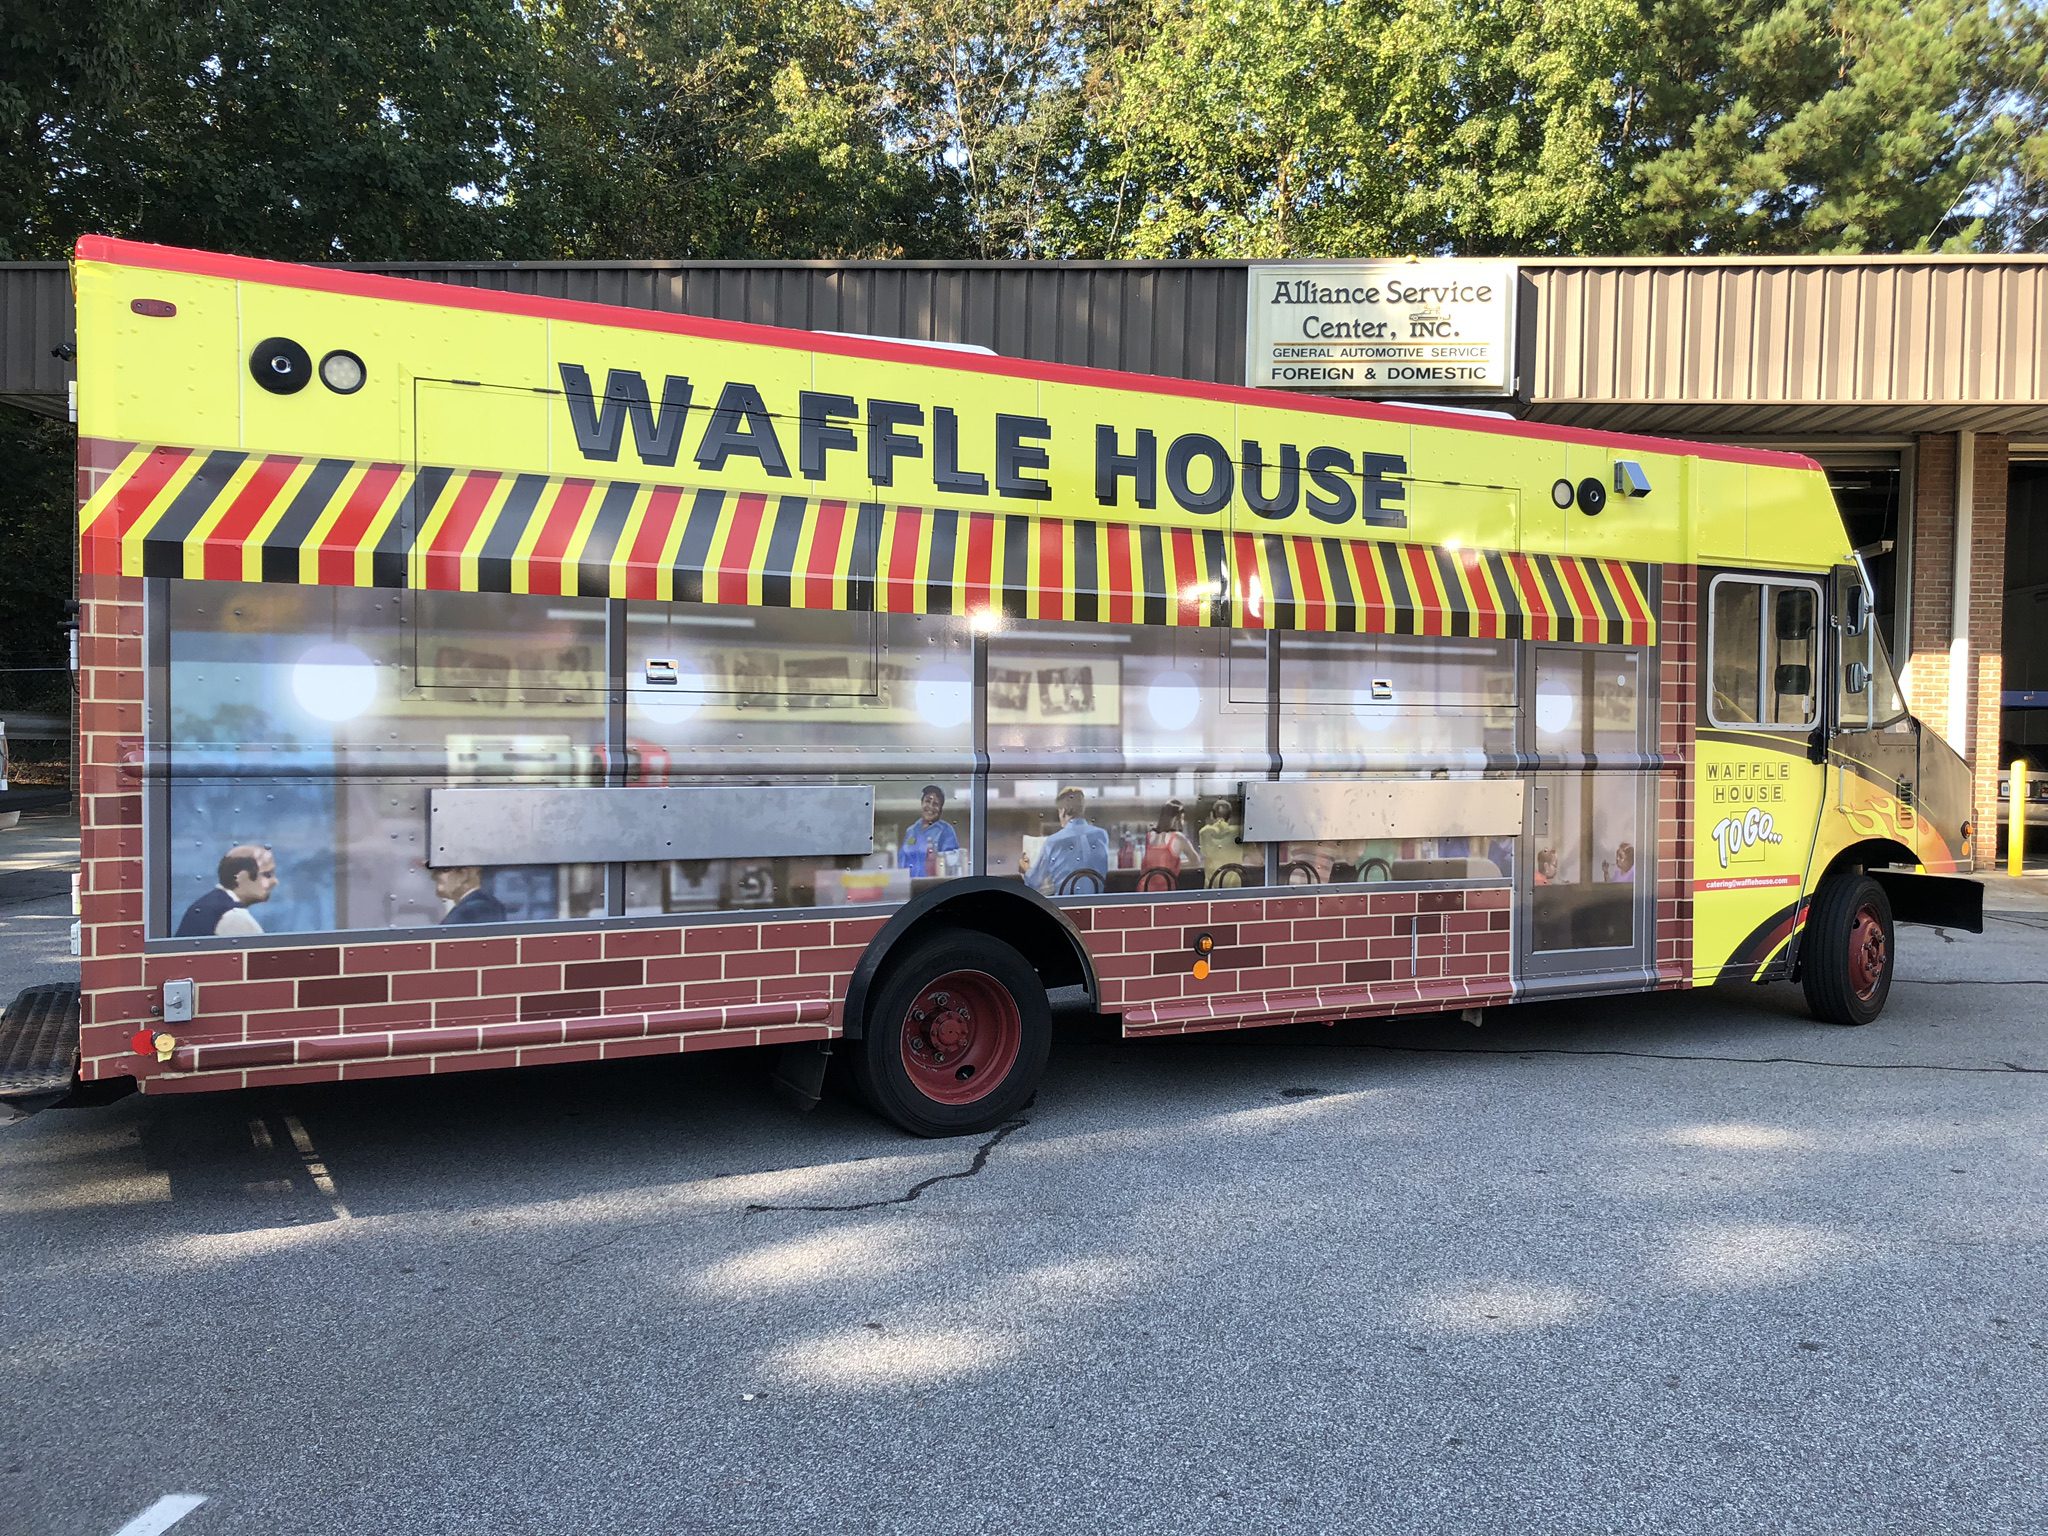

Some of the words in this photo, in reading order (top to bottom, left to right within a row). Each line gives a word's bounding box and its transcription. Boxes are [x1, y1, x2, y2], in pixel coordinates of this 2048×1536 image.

[1271, 280, 1380, 304] Alliance
[1386, 280, 1493, 304] Service
[1302, 315, 1397, 340] Center,
[1409, 321, 1460, 338] INC.
[1272, 347, 1334, 358] GENERAL
[1340, 347, 1424, 358] AUTOMOTIVE
[1431, 347, 1488, 357] SERVICE
[1272, 367, 1354, 380] FOREIGN
[1364, 367, 1376, 380] &
[1387, 367, 1487, 380] DOMESTIC
[557, 362, 1052, 500] WAFFLE
[1095, 423, 1408, 529] HOUSE
[1707, 764, 1789, 779] WAFFLE
[1714, 786, 1782, 801] HOUSE
[1706, 878, 1788, 888] catering@wafflehouse.com
